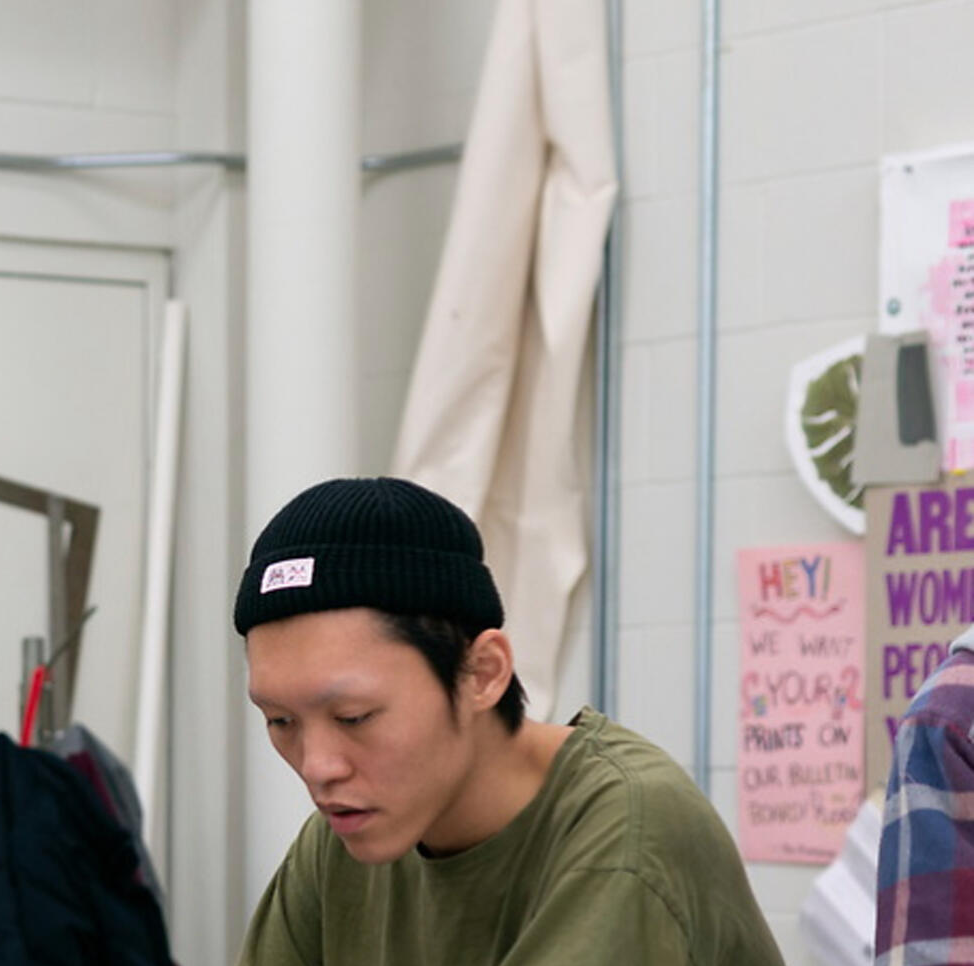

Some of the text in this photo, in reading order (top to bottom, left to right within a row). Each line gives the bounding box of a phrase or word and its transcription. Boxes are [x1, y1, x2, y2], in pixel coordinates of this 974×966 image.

[886, 486, 974, 556] ARE
[758, 557, 831, 600] HEY!
[885, 568, 974, 627] WOM
[751, 630, 779, 656] WE
[764, 669, 833, 708] YOUR
[883, 641, 951, 700] PEO
[744, 722, 805, 752] PRINTS
[817, 721, 852, 747] ON
[744, 766, 783, 792] OUR
